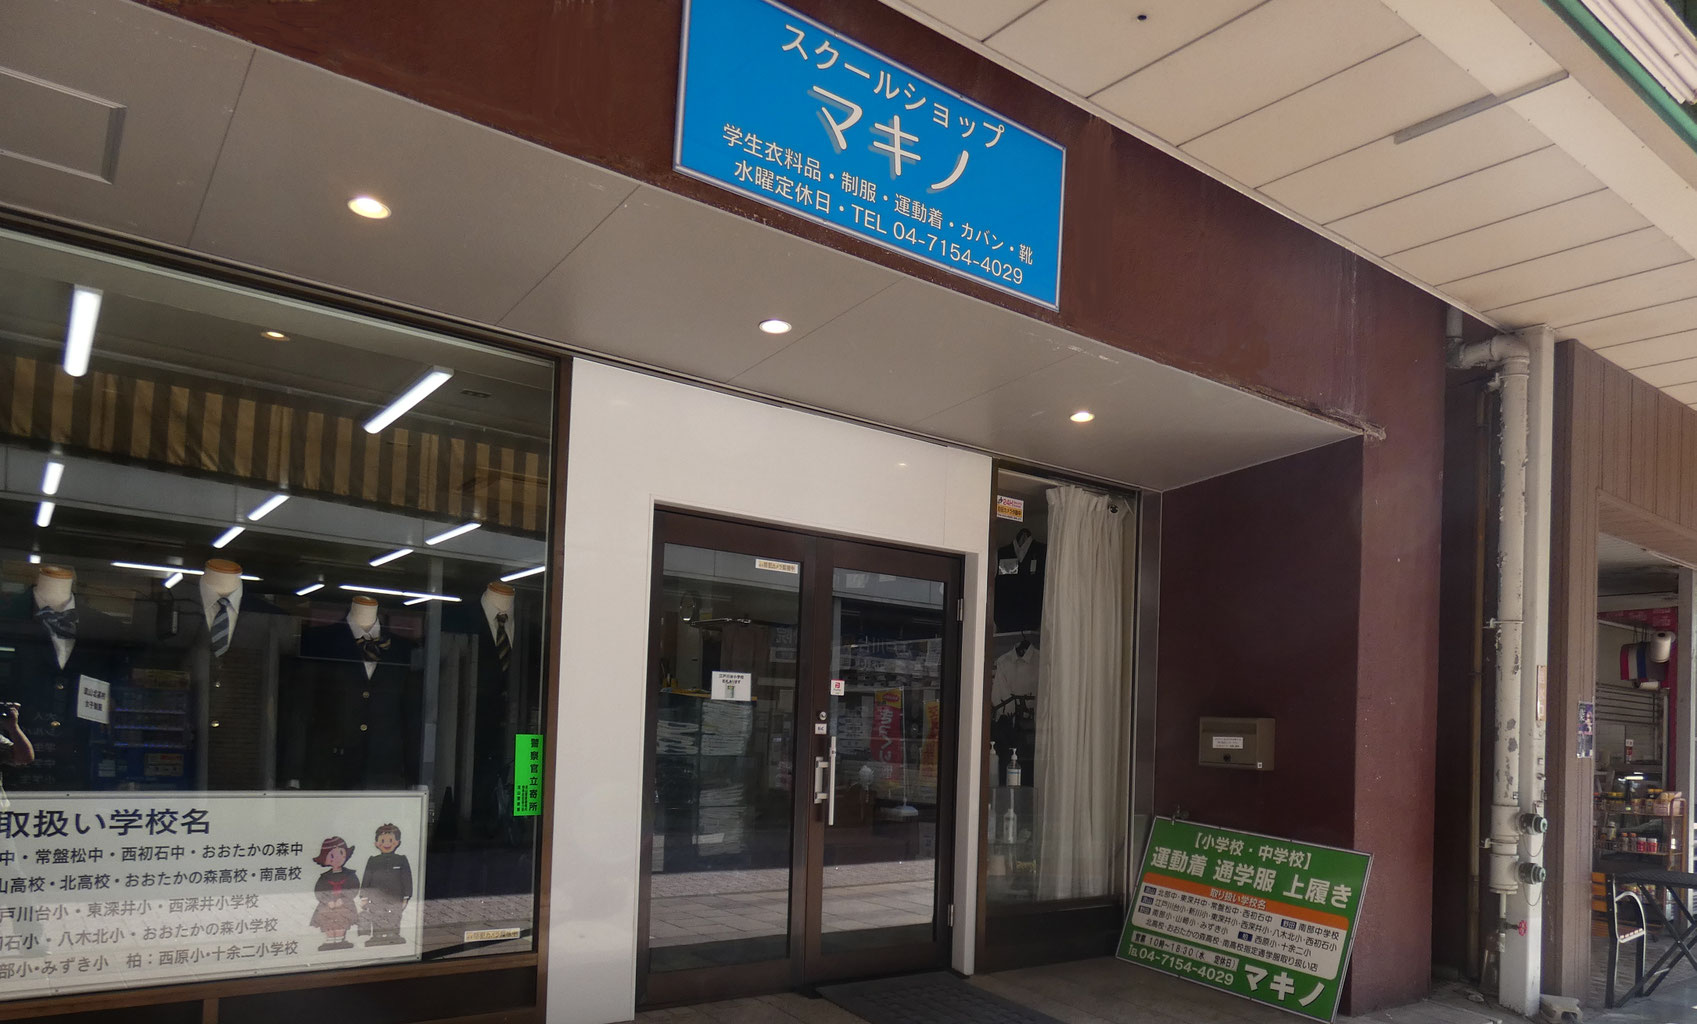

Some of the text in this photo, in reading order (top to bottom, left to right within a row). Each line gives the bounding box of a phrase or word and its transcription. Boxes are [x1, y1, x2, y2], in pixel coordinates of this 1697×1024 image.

[781, 23, 1005, 148] スクールショップ
[810, 84, 969, 191] マキノ
[722, 122, 1034, 265] 学生衣料品・制服・運動着・カバン・靴
[733, 159, 1023, 285] 水曜定休日・TEL 04-7154-4029
[529, 738, 539, 811] 警察官立寄所
[0, 808, 210, 839] 取扱い学校名
[1150, 846, 1352, 909] 運動着 通学服 上履き
[1210, 887, 1266, 911] 取り扱い学校名
[1139, 948, 1235, 986] 04-7154-4029
[1244, 963, 1325, 1007] マキノ
